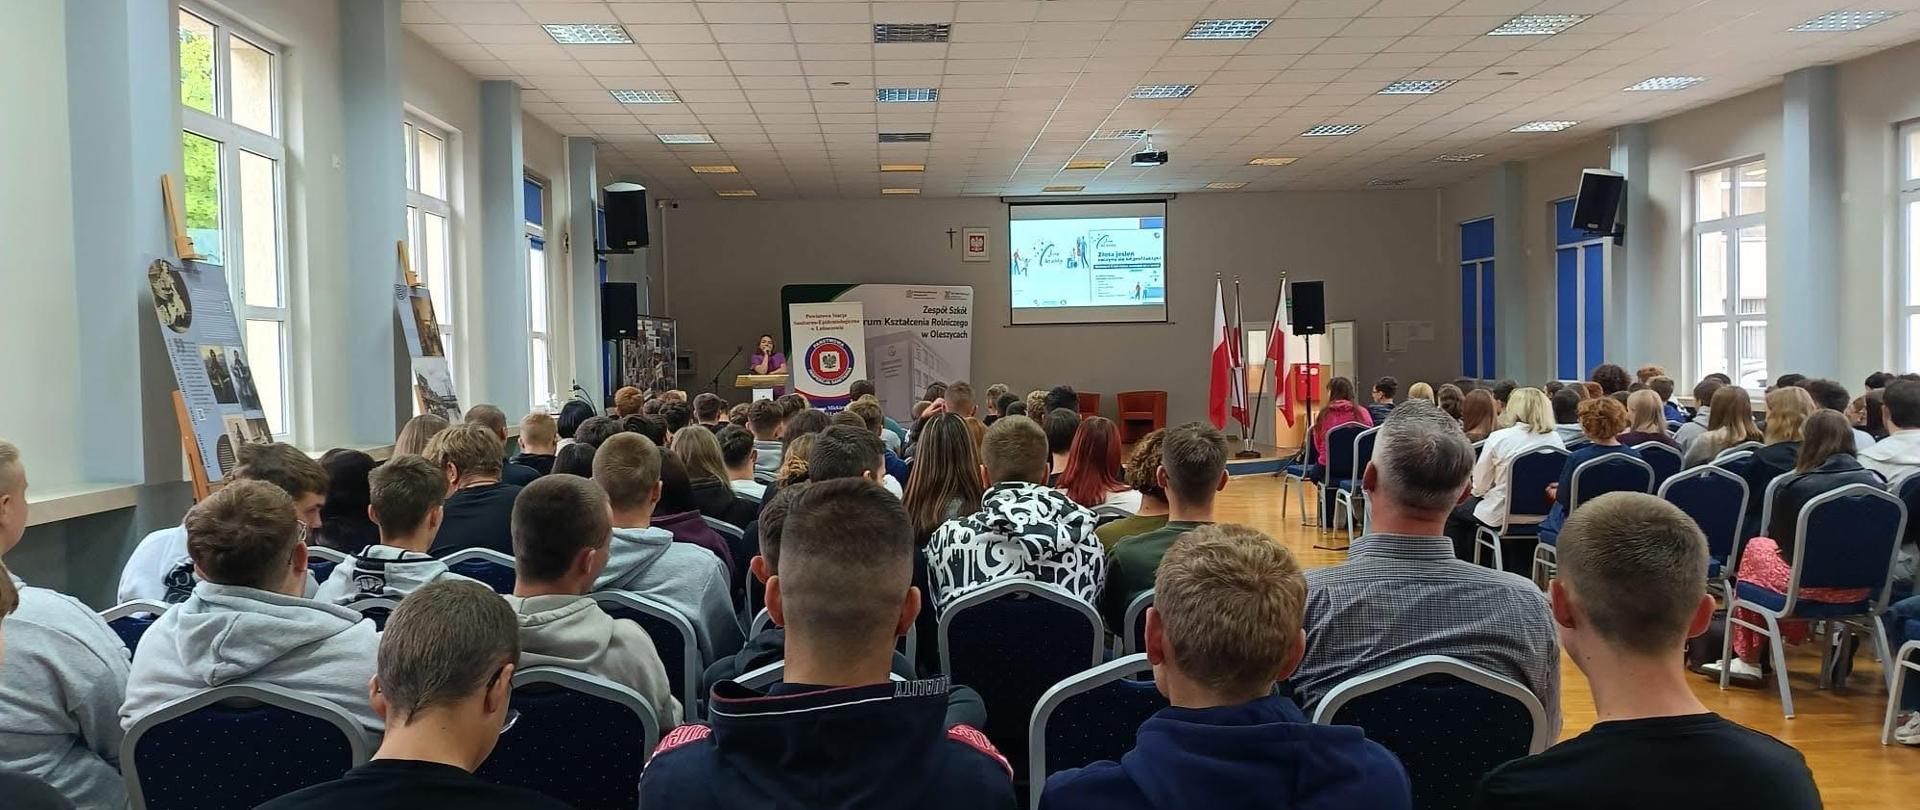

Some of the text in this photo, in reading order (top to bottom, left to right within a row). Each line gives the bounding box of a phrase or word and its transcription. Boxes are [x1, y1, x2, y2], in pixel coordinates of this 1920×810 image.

[922, 305, 968, 315] Zespół Szkół
[884, 318, 930, 326] Kształcenia
[931, 318, 969, 328] Rolniczego
[930, 330, 968, 340] Oleszycach
